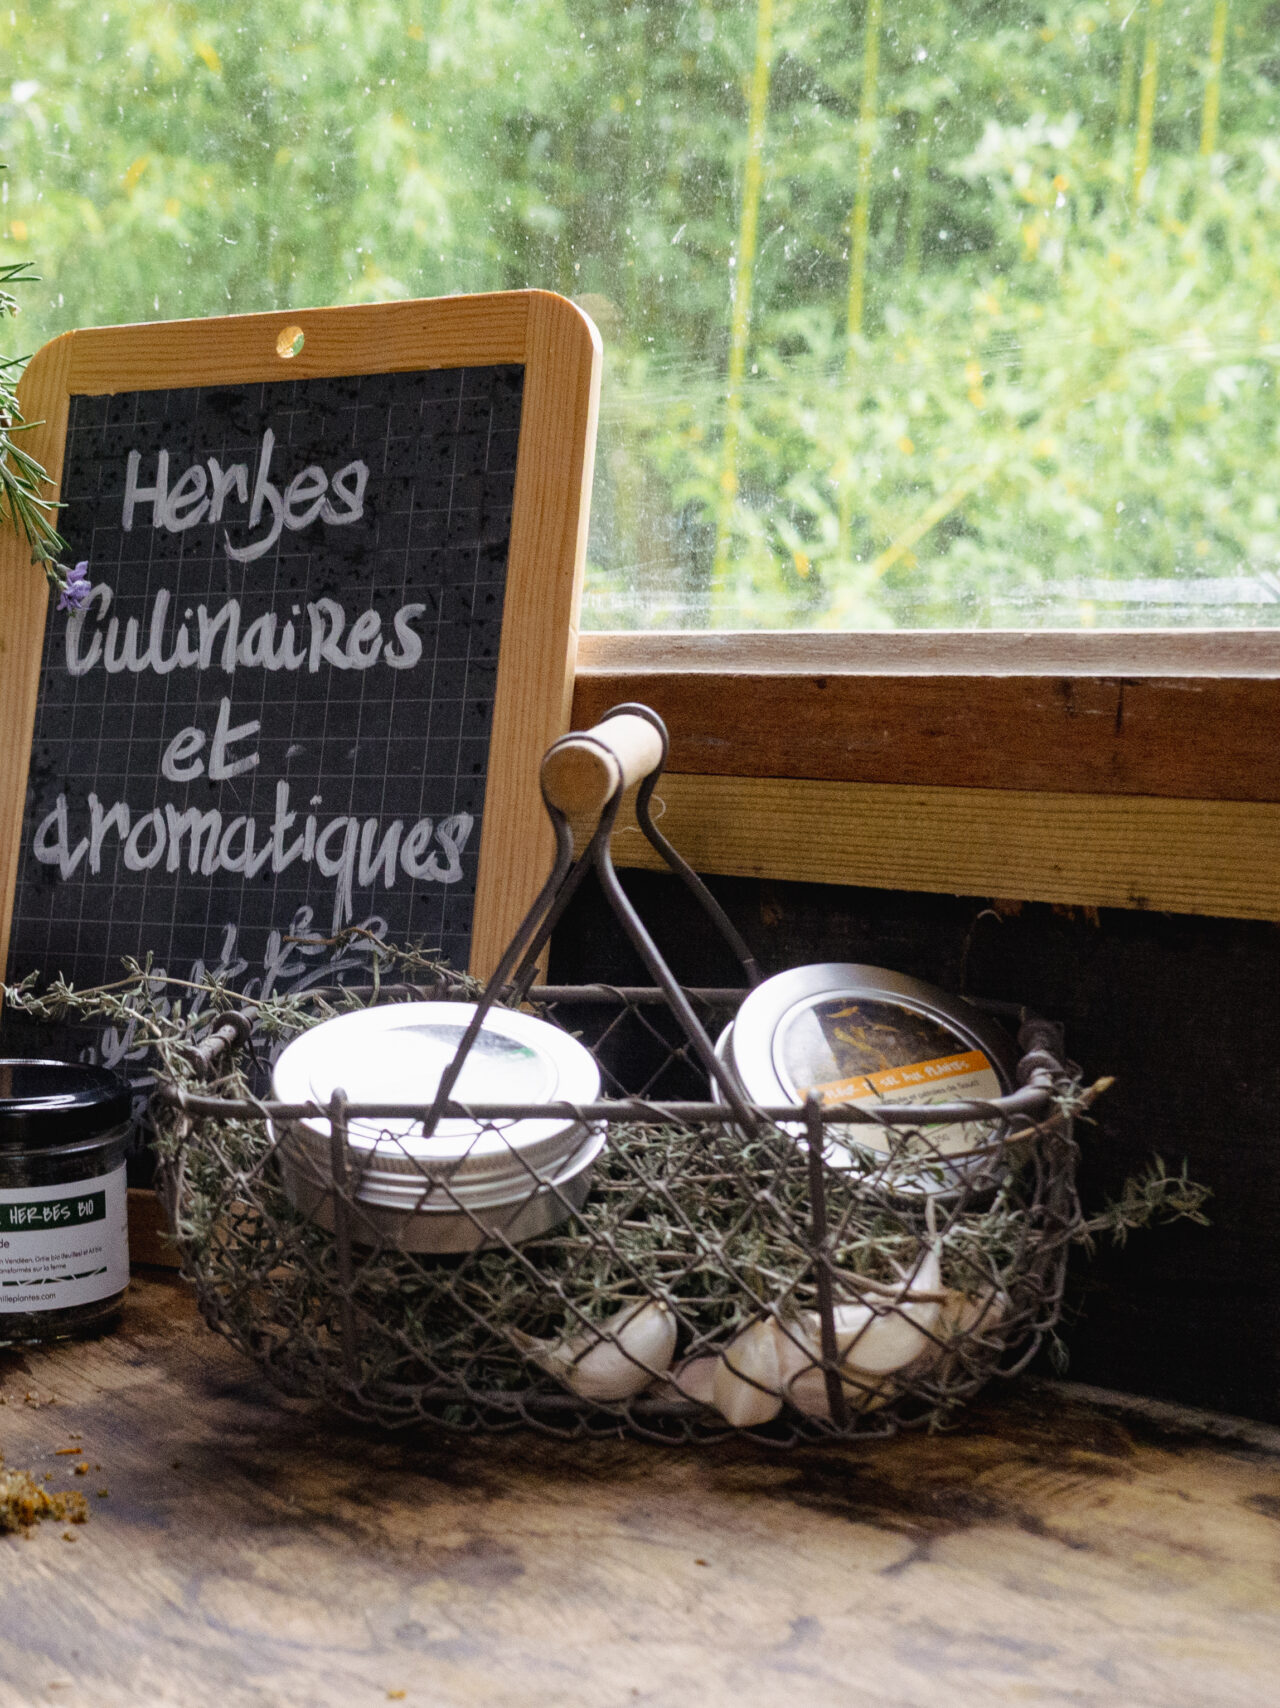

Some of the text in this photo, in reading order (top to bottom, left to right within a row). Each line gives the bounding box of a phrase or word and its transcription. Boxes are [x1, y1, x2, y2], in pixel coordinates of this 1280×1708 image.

[122, 427, 370, 561] Herbes
[161, 696, 262, 783] et
[34, 779, 475, 933] aromatiques
[9, 1202, 71, 1224] HERBES
[78, 1199, 94, 1218] BIO
